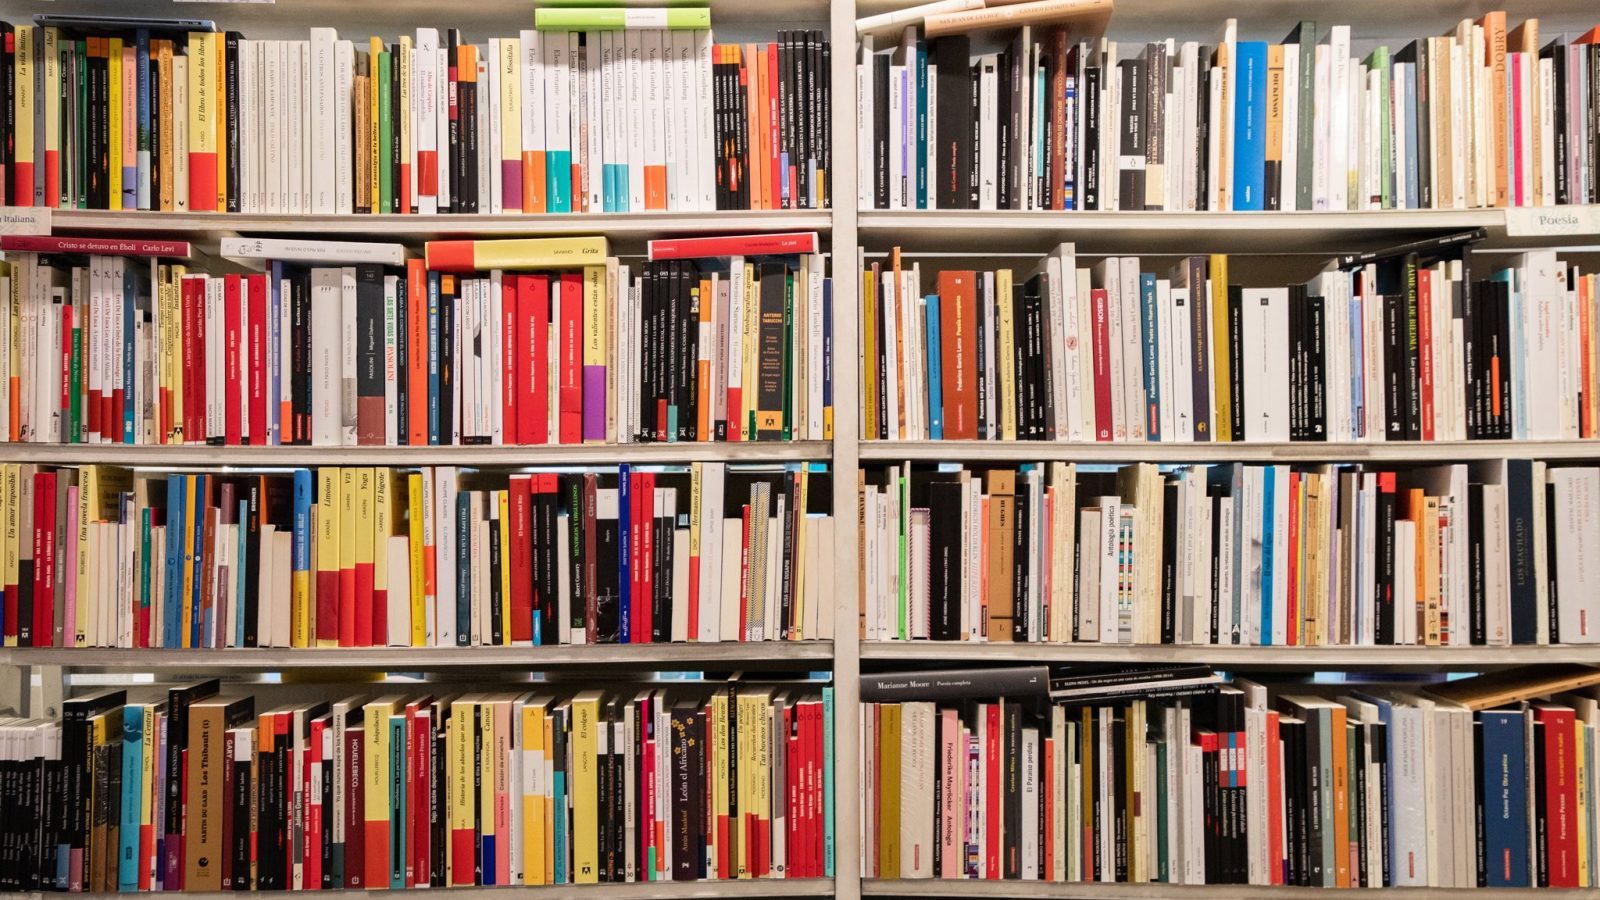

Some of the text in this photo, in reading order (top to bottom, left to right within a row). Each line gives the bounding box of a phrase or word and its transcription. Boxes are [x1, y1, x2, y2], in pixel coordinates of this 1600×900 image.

[1495, 28, 1504, 72] DOBRY
[19, 67, 26, 76] La
[199, 87, 205, 96] de
[4, 215, 35, 224] Italiana
[58, 241, 78, 249] Cristo
[87, 241, 108, 250] detuvo
[120, 242, 136, 251] Éboli
[142, 244, 160, 252] Carlo
[1408, 264, 1417, 350] JAIME GIL DE BIEDMA
[81, 471, 89, 500] francesa
[693, 486, 699, 494] de
[378, 495, 384, 504] El
[1107, 506, 1115, 527] poética
[9, 529, 15, 538] Un
[1515, 518, 1524, 566] MACHADO
[878, 680, 930, 690] Marianne Moore
[144, 710, 152, 746] La Central
[483, 707, 491, 731] Canoas
[201, 731, 209, 769] Thibault
[679, 739, 687, 771] Africano
[680, 782, 688, 802] León
[946, 776, 954, 811] Mayröcker
[201, 809, 207, 818] DU
[946, 816, 954, 846] Antología
